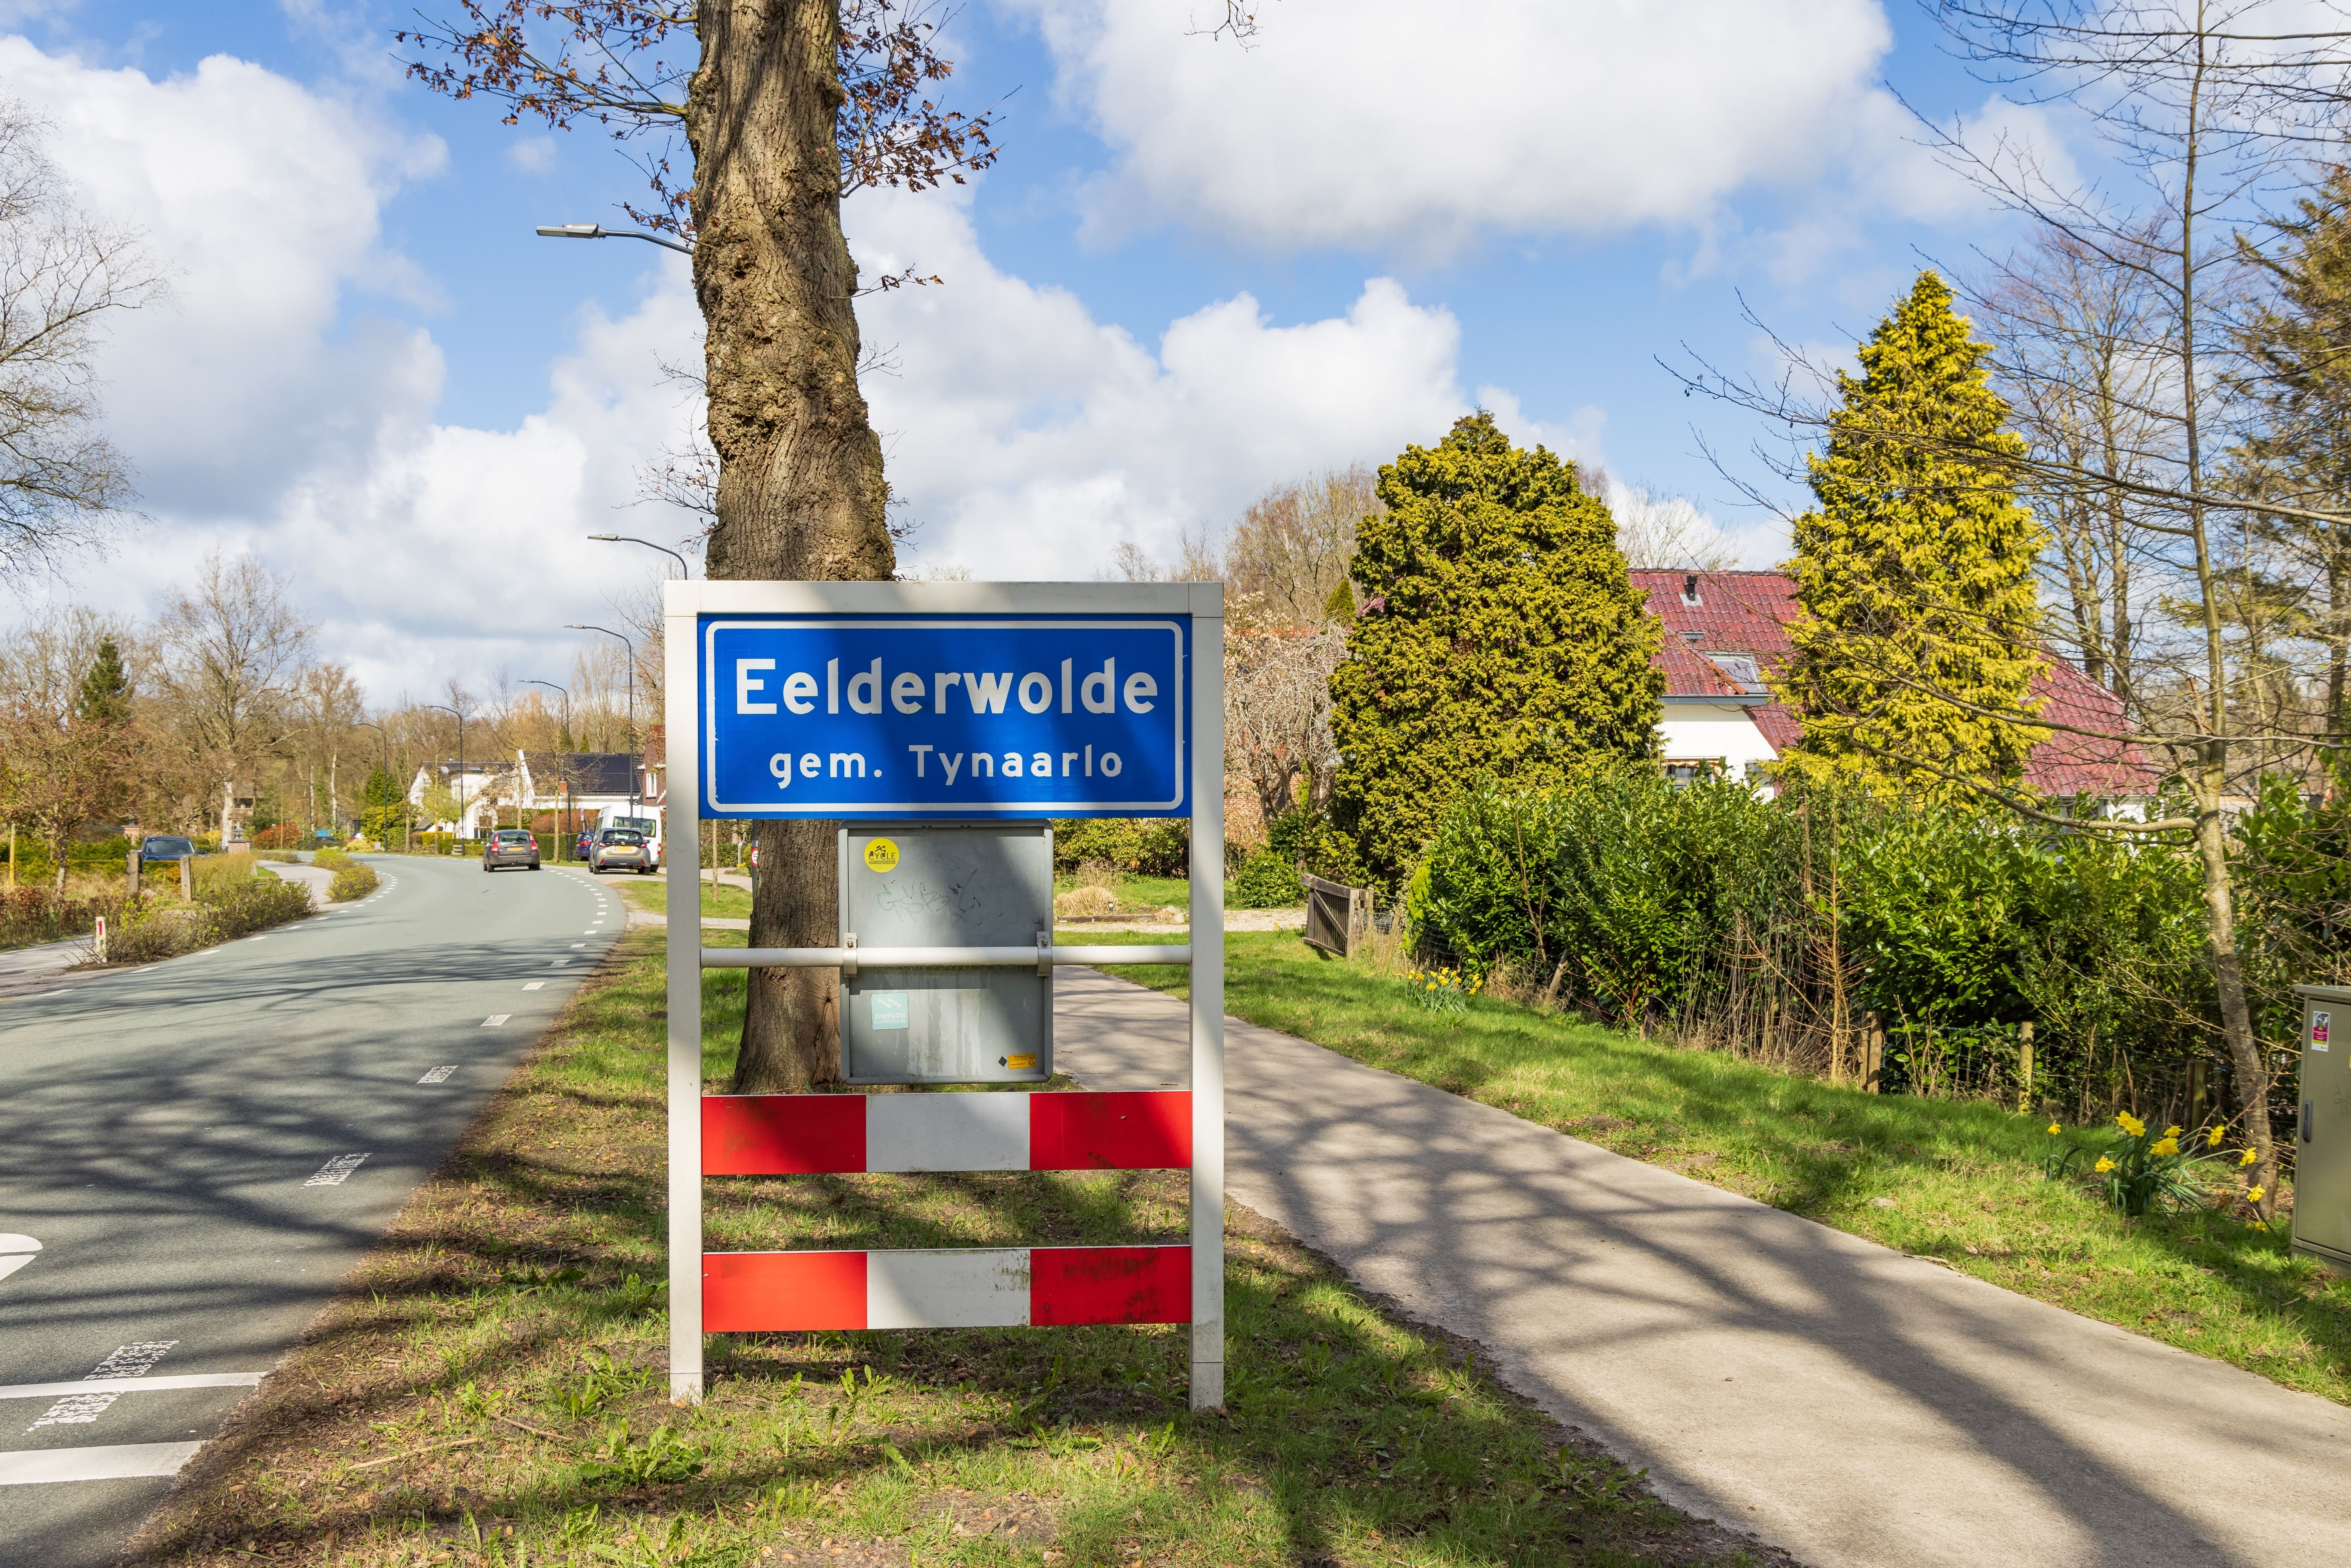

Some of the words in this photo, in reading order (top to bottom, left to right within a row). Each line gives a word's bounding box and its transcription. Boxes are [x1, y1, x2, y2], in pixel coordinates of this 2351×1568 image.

[736, 657, 1158, 714] Eelderwolde
[769, 753, 882, 789] gem.
[909, 744, 1122, 785] Tynaarlo
